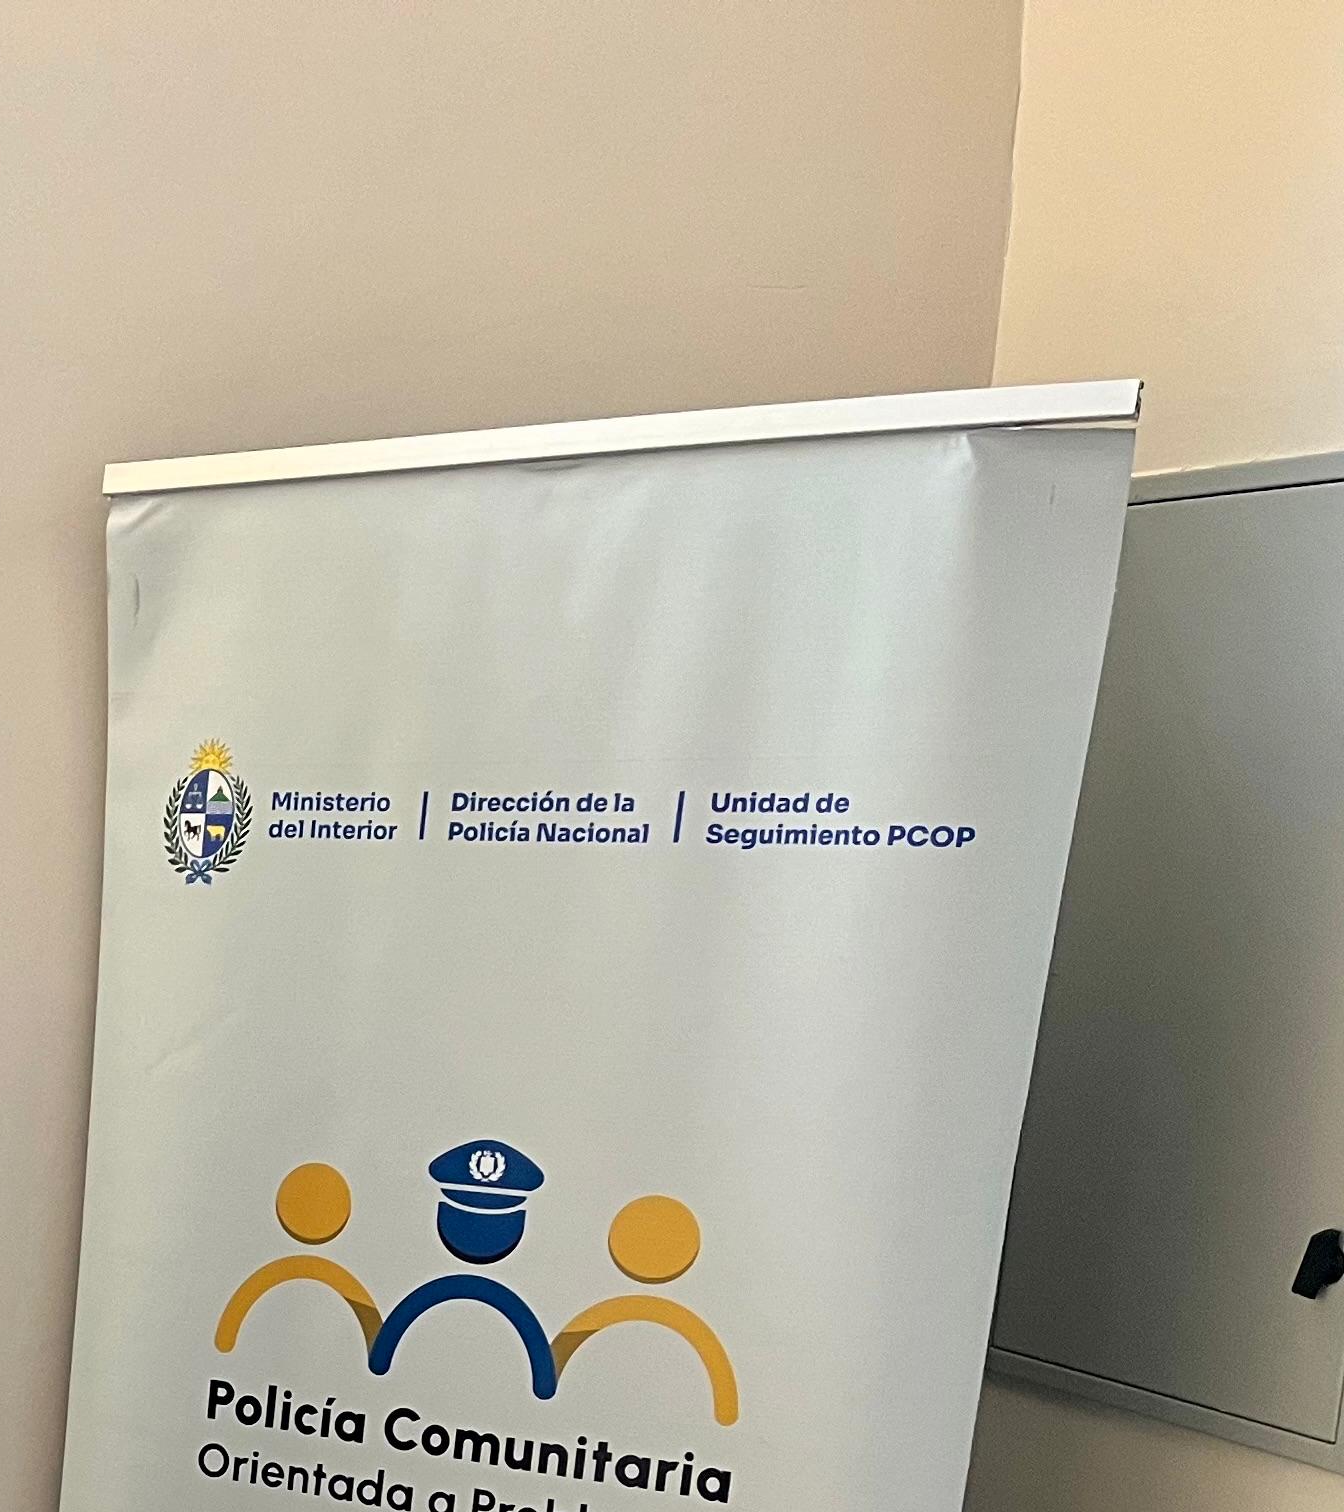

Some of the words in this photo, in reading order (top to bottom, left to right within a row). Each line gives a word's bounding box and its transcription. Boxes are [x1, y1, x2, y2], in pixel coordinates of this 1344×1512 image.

[271, 792, 391, 812] Ministerio
[450, 792, 571, 814] Dirección
[575, 793, 610, 814] de
[613, 793, 635, 814] la
[710, 793, 808, 815] Unidad
[815, 793, 850, 815] de
[269, 820, 304, 839] del
[310, 820, 398, 840] Interior
[448, 821, 531, 843] Policía
[536, 823, 650, 845] Nacional
[705, 823, 881, 851] Seguimiento
[886, 825, 976, 849] PCOP
[206, 1379, 366, 1445] Policía
[384, 1406, 733, 1505] Comunitaria
